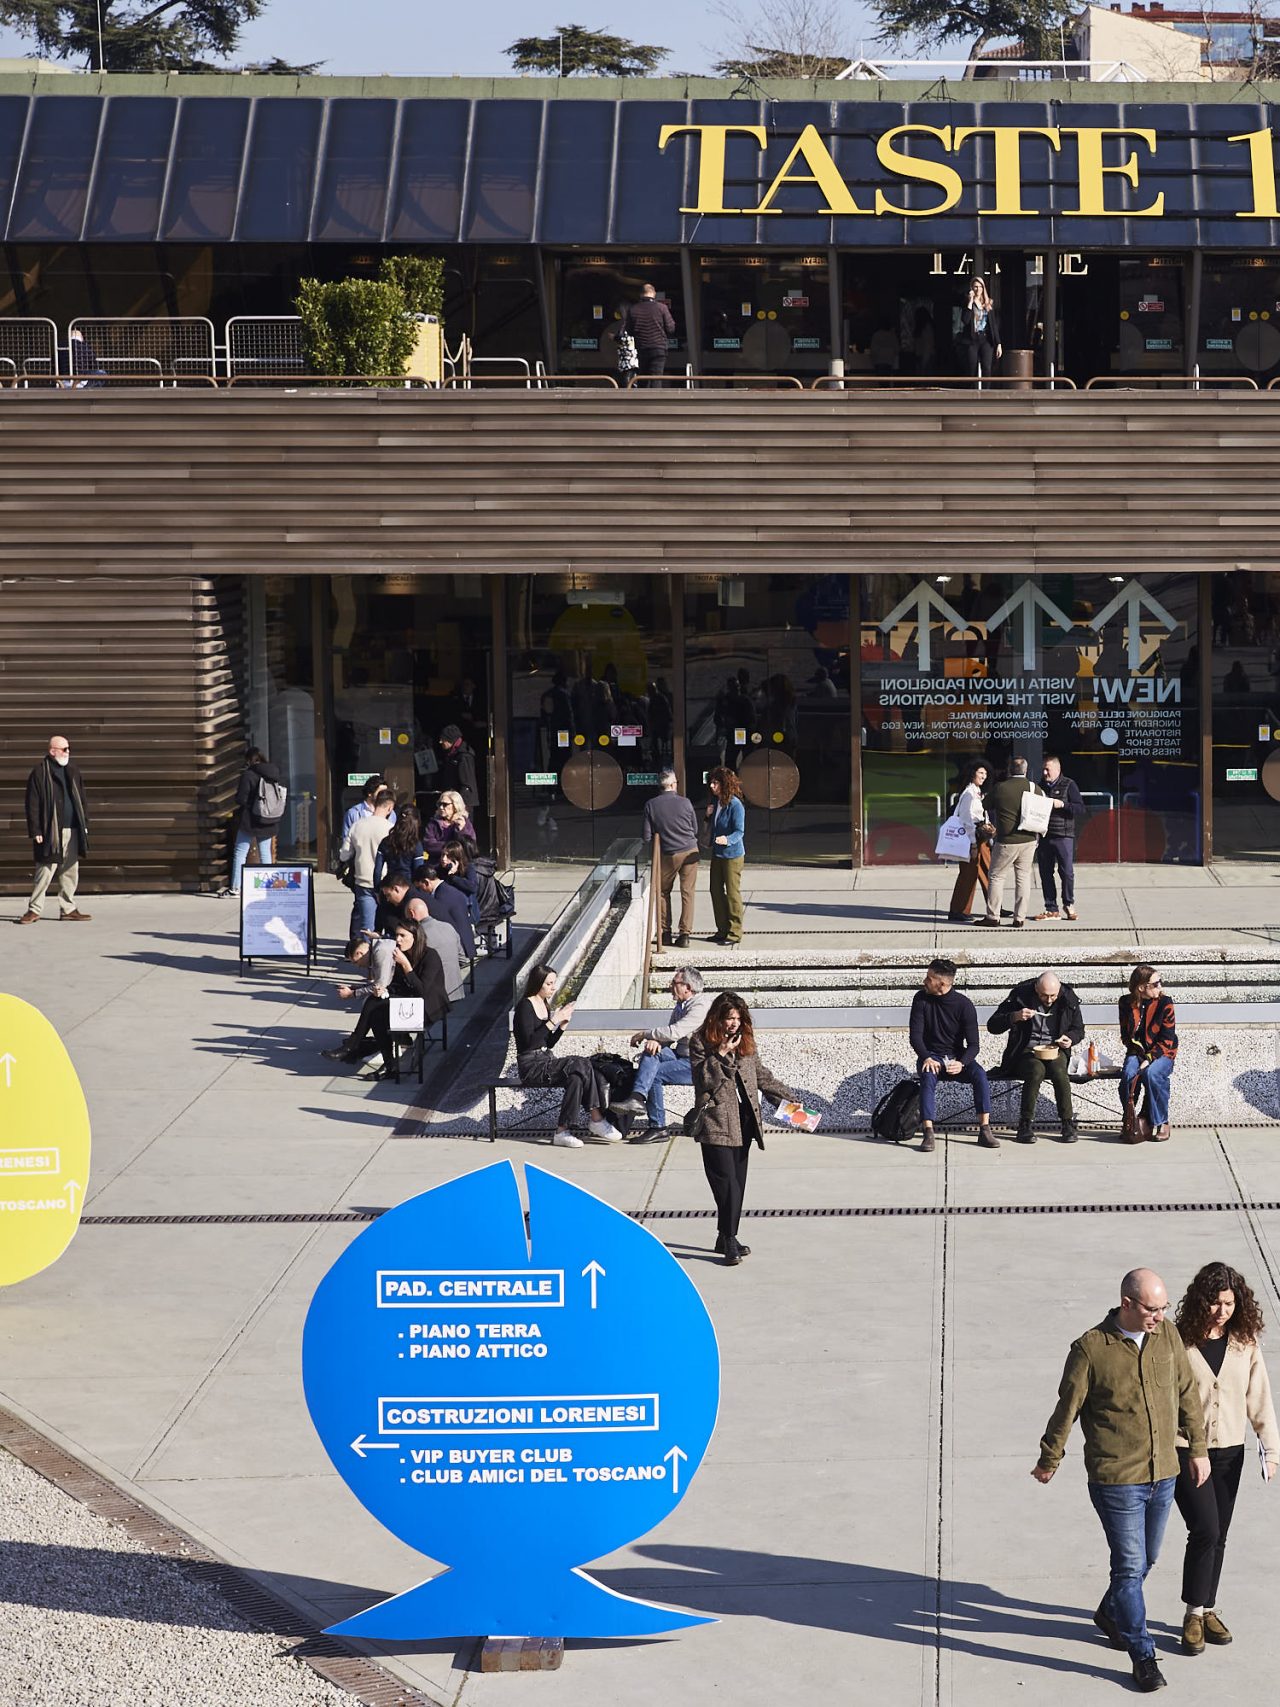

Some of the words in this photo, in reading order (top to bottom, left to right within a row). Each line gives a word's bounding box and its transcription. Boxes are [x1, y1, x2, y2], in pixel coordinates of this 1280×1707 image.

[659, 125, 1165, 216] TASTE
[0, 1156, 50, 1169] ENESI
[0, 1198, 67, 1211] TOSCANO
[385, 1280, 433, 1297] PAD.
[438, 1280, 553, 1297] CENTRALE
[409, 1324, 471, 1339] PIANO
[475, 1324, 542, 1338] TERRA
[409, 1344, 471, 1359] PIANO
[475, 1343, 548, 1359] ATTICO
[386, 1407, 534, 1425] COSTRUZIONI
[540, 1405, 646, 1423] LORENESI
[410, 1449, 444, 1464] VIP
[449, 1449, 516, 1464] BUYER
[520, 1448, 573, 1463] CLUB
[411, 1469, 464, 1484] CLUB
[467, 1469, 525, 1484] AMICI
[530, 1468, 568, 1483] DEL
[572, 1465, 667, 1482] TOSCANO
